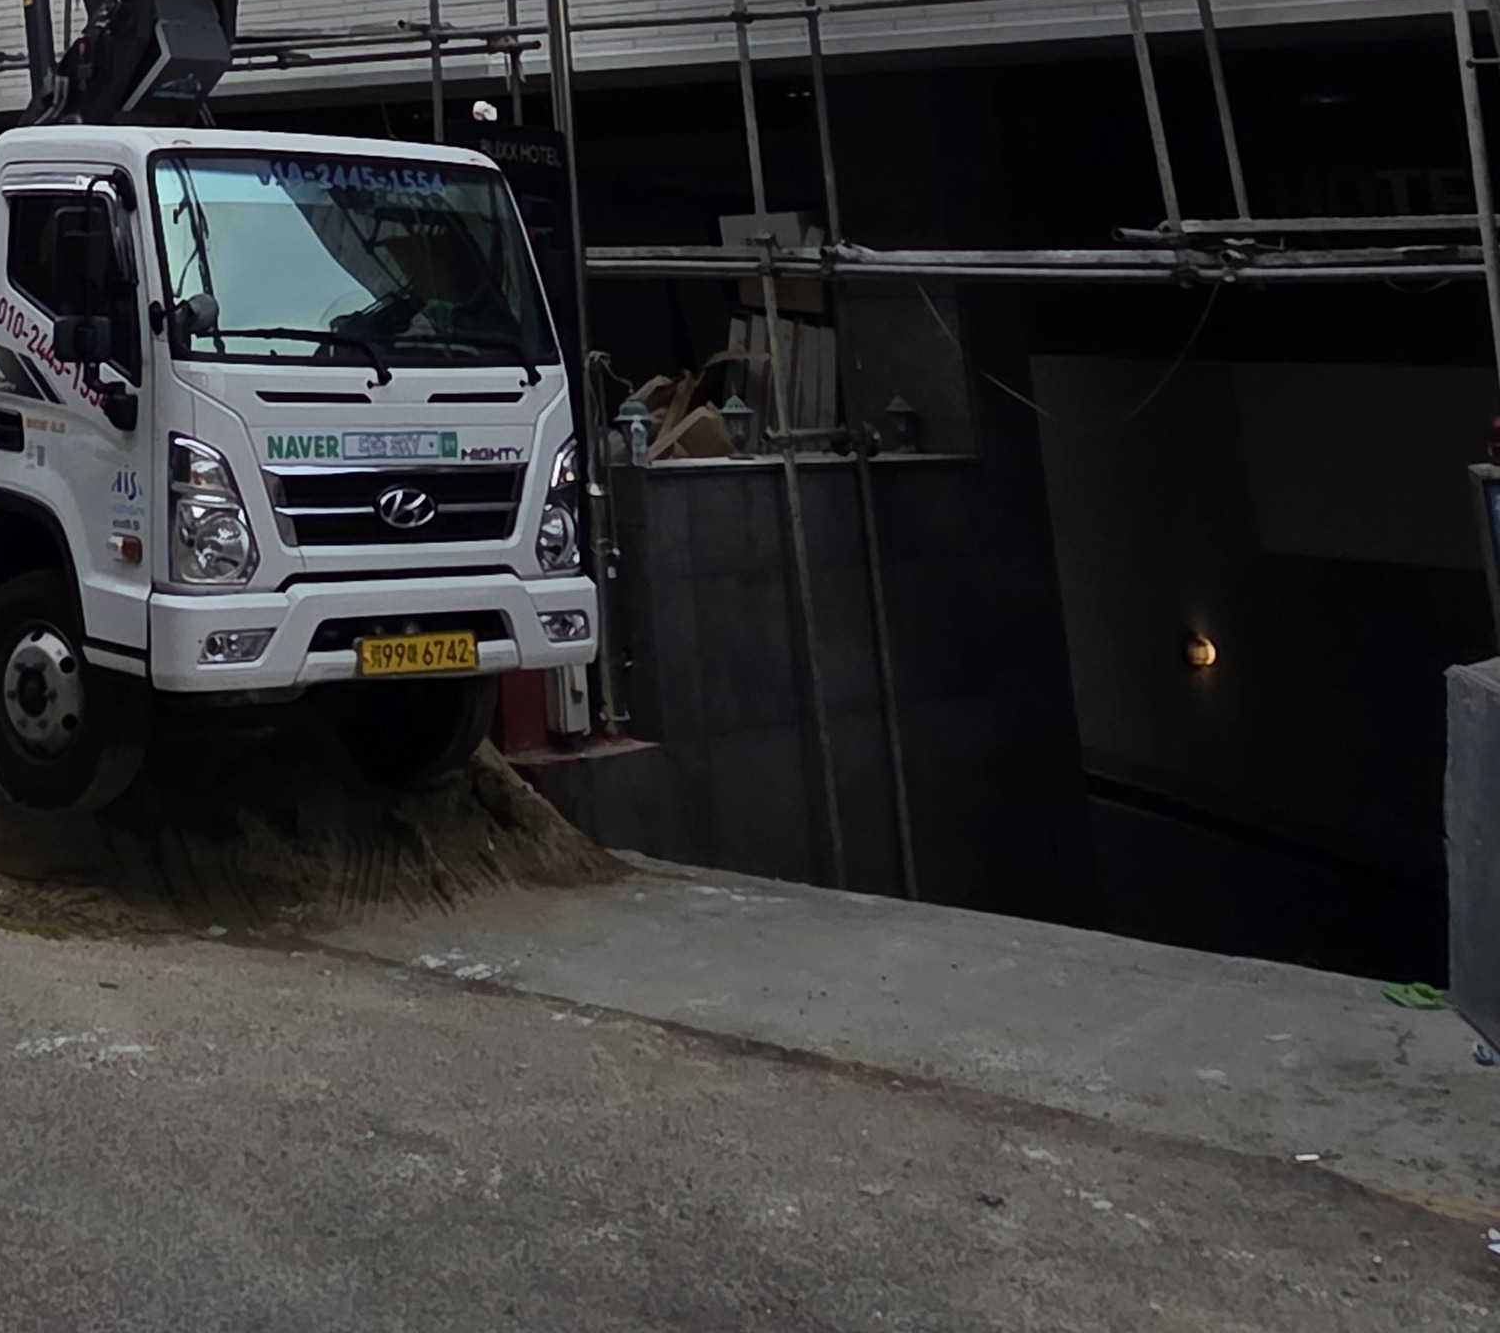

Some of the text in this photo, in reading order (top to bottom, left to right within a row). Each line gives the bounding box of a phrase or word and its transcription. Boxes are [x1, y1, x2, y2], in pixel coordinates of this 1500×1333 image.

[267, 435, 339, 459] NAVER
[460, 446, 524, 460] MIGHTY
[422, 638, 469, 666] 6742
